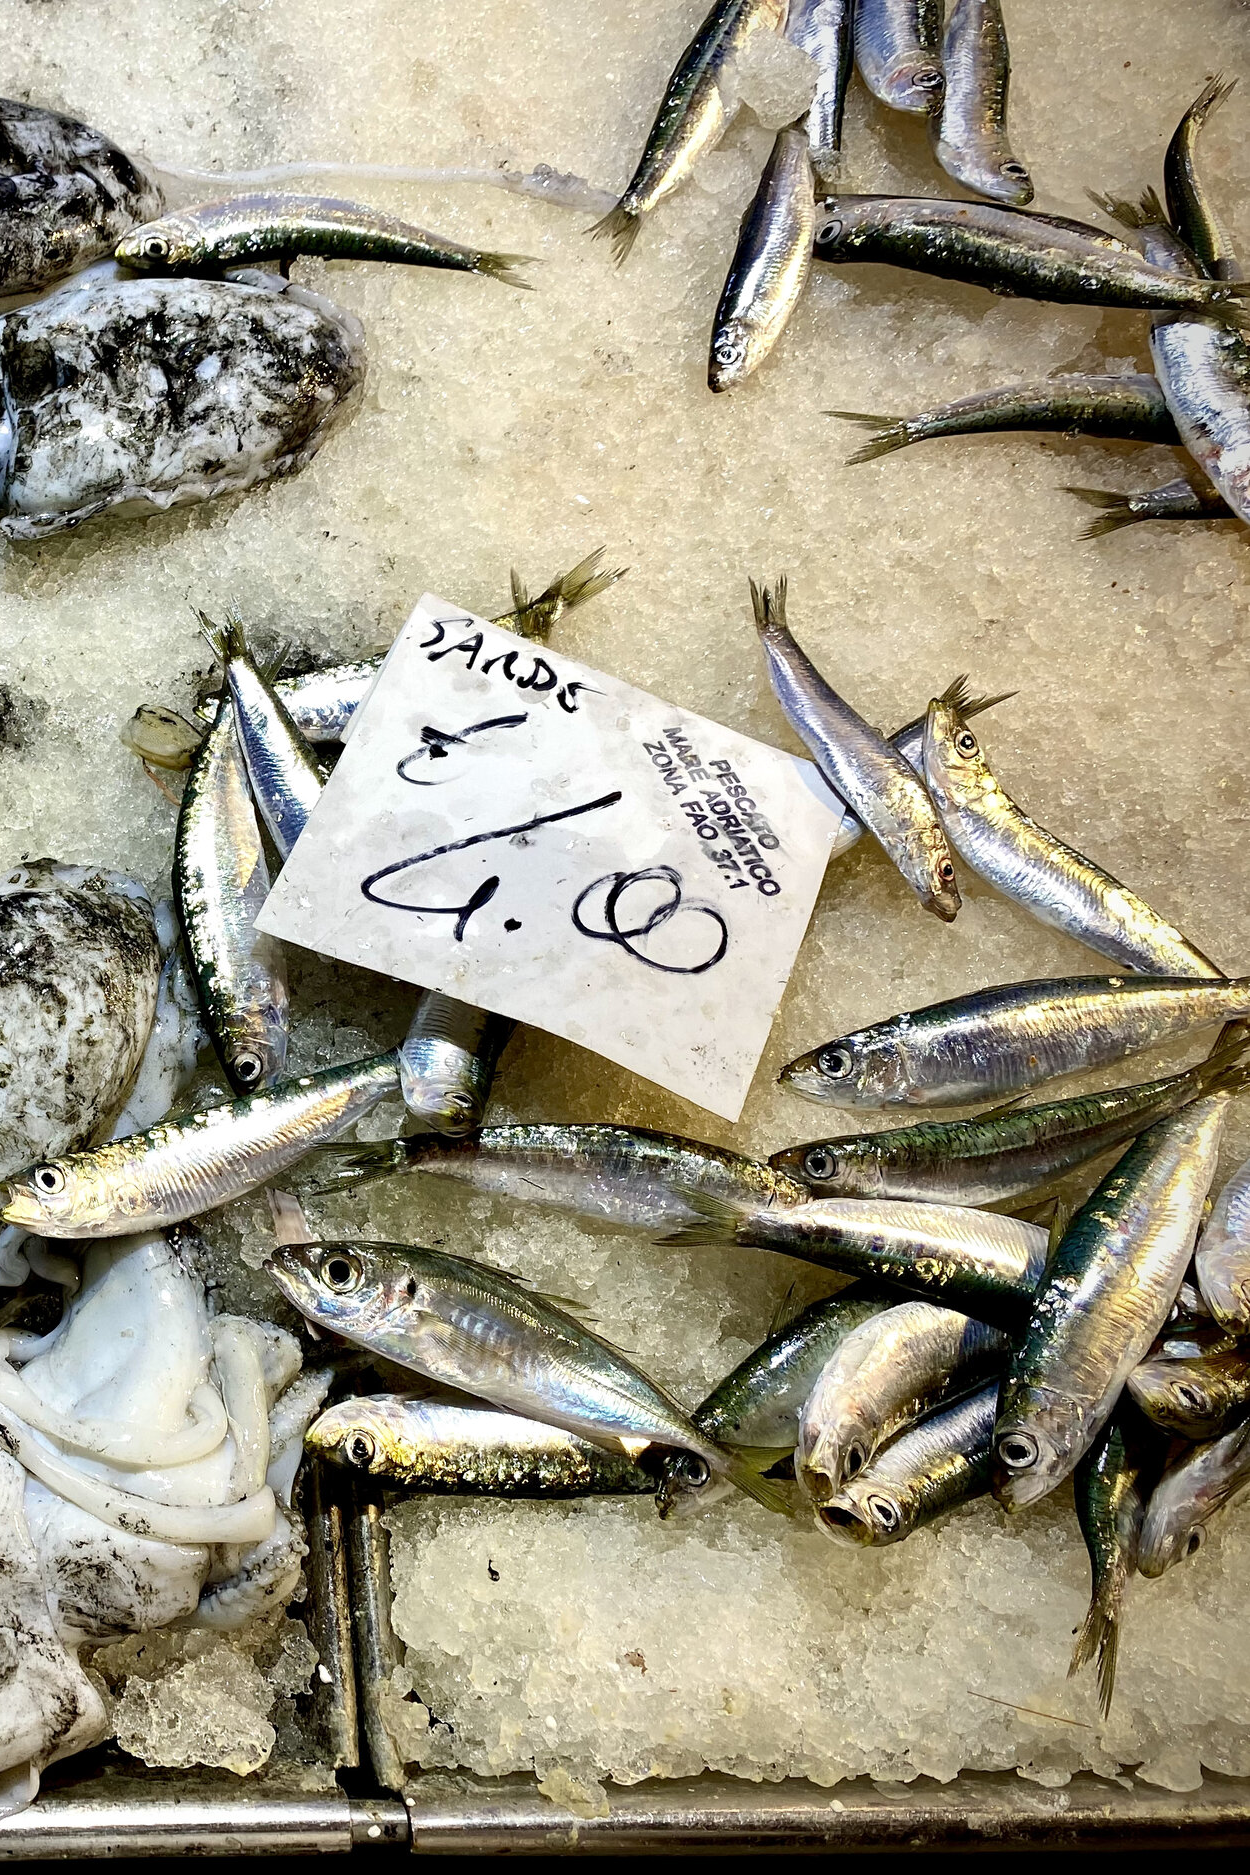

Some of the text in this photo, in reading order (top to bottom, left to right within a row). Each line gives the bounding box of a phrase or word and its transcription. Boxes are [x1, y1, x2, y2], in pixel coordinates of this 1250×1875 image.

[642, 740, 750, 889] ZONA FAO 37.1
[662, 727, 781, 897] MARE ADRIATICO
[708, 759, 780, 850] PESCATO
